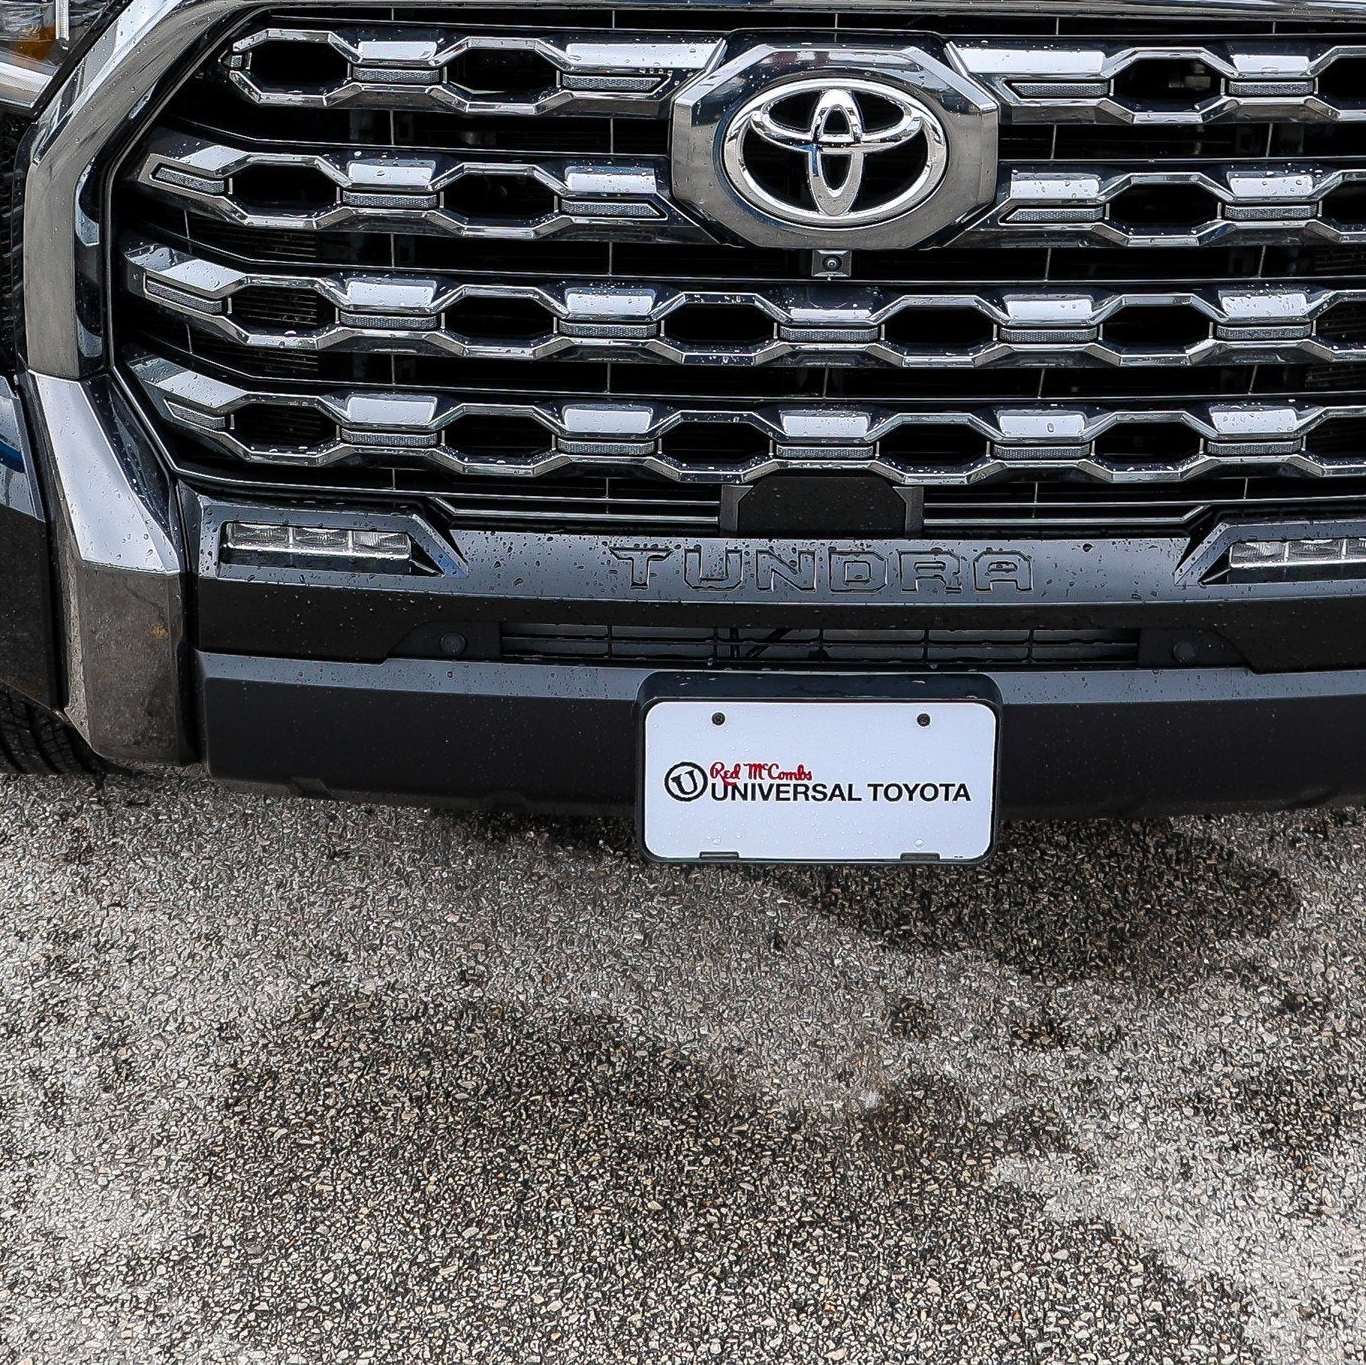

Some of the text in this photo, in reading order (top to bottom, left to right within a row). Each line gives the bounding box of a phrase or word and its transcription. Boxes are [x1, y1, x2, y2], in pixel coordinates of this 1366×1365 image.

[608, 546, 1033, 593] TUNDRA
[710, 761, 813, 785] Red McCombs
[710, 782, 972, 802] UNIVERSAL TOYOTA
